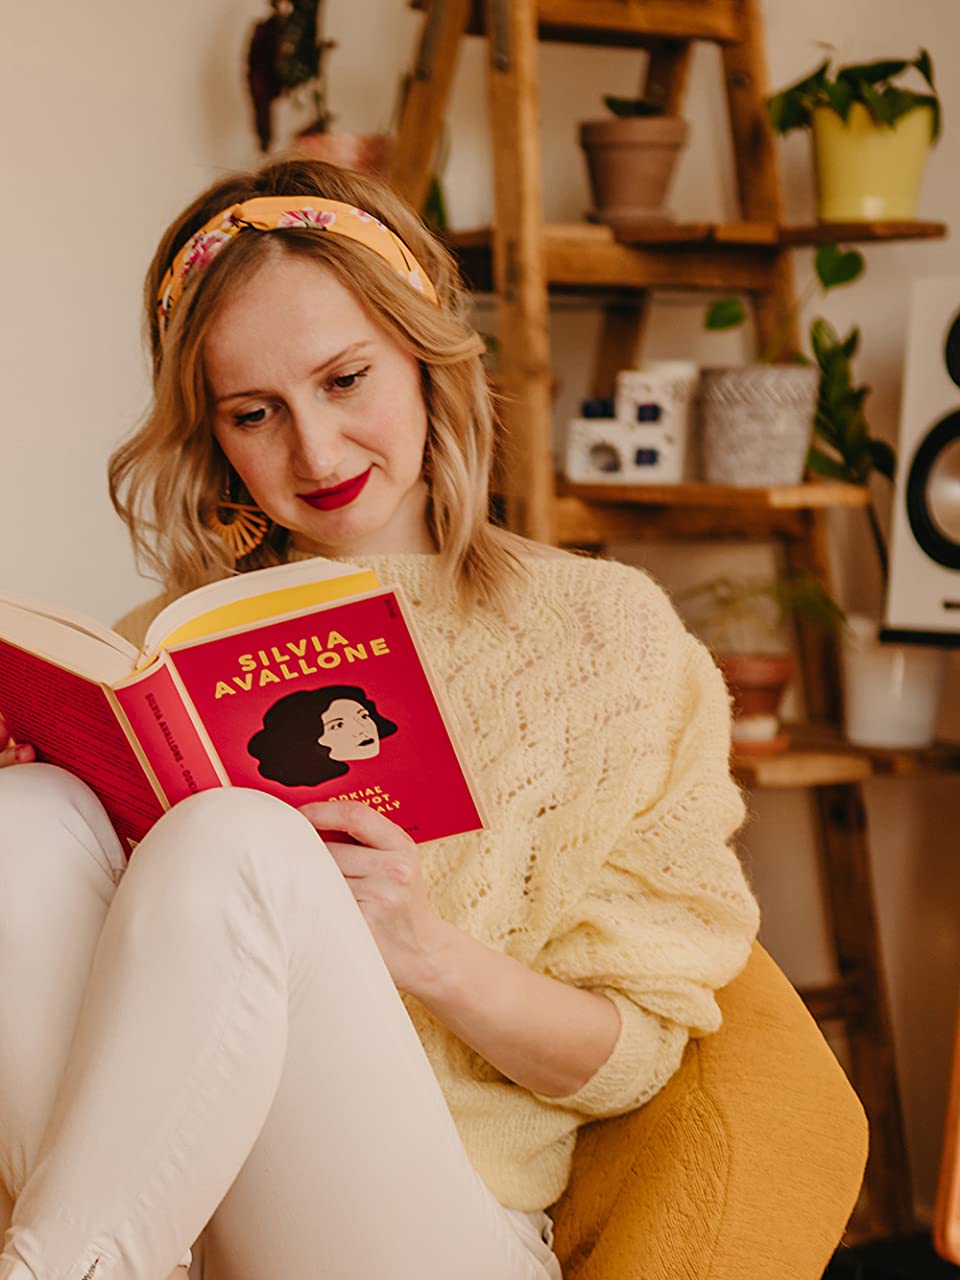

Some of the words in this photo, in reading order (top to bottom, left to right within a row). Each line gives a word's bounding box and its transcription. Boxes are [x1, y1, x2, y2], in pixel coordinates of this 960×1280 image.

[214, 638, 390, 699] AVALLONE
[238, 631, 348, 672] SILVIA
[145, 692, 161, 722] SILVIA
[158, 718, 184, 763] AVALLONE
[361, 793, 390, 806] VOT
